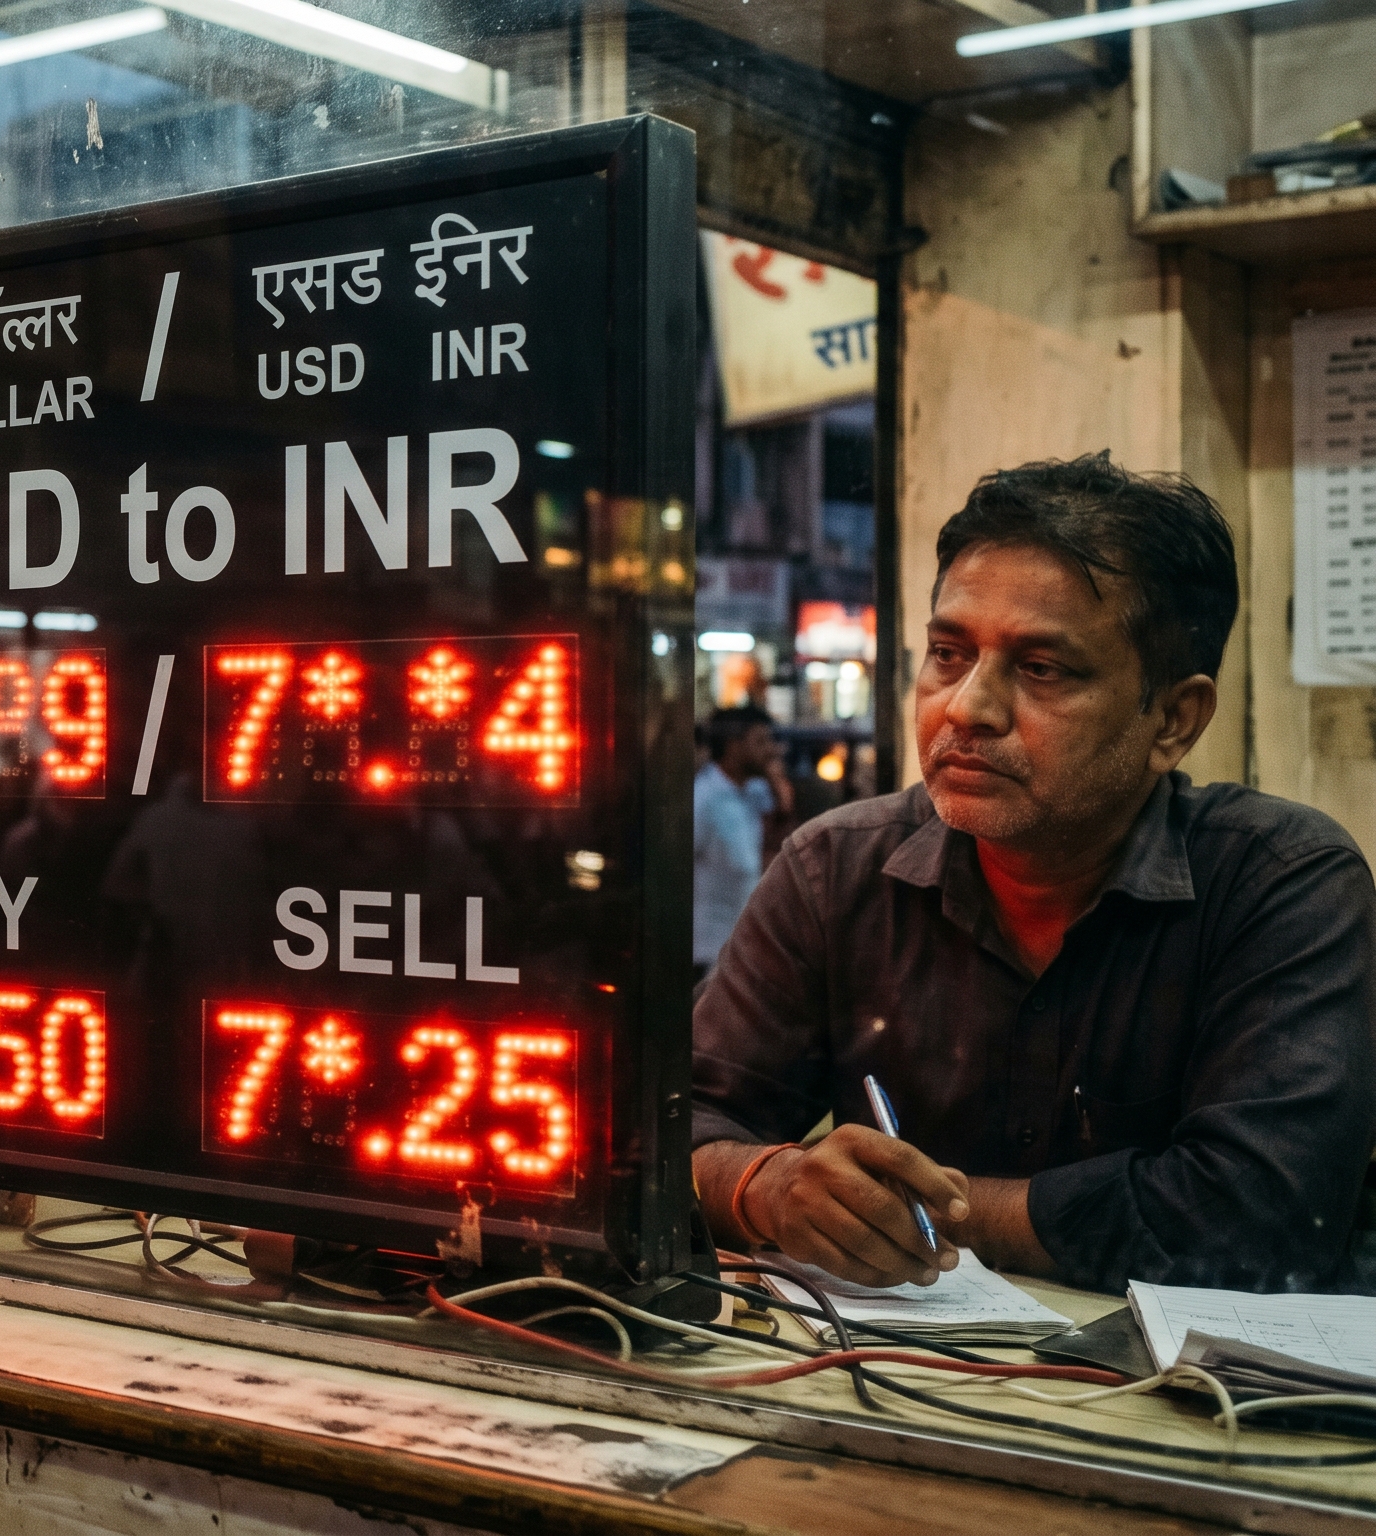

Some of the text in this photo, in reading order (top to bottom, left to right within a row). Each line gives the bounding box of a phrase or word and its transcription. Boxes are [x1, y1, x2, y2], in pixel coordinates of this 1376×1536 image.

[252, 249, 384, 329] एसड
[259, 343, 364, 399] USD
[433, 323, 529, 381] INR
[121, 462, 235, 583] to
[285, 428, 528, 575] INR
[274, 887, 519, 983] SELL
